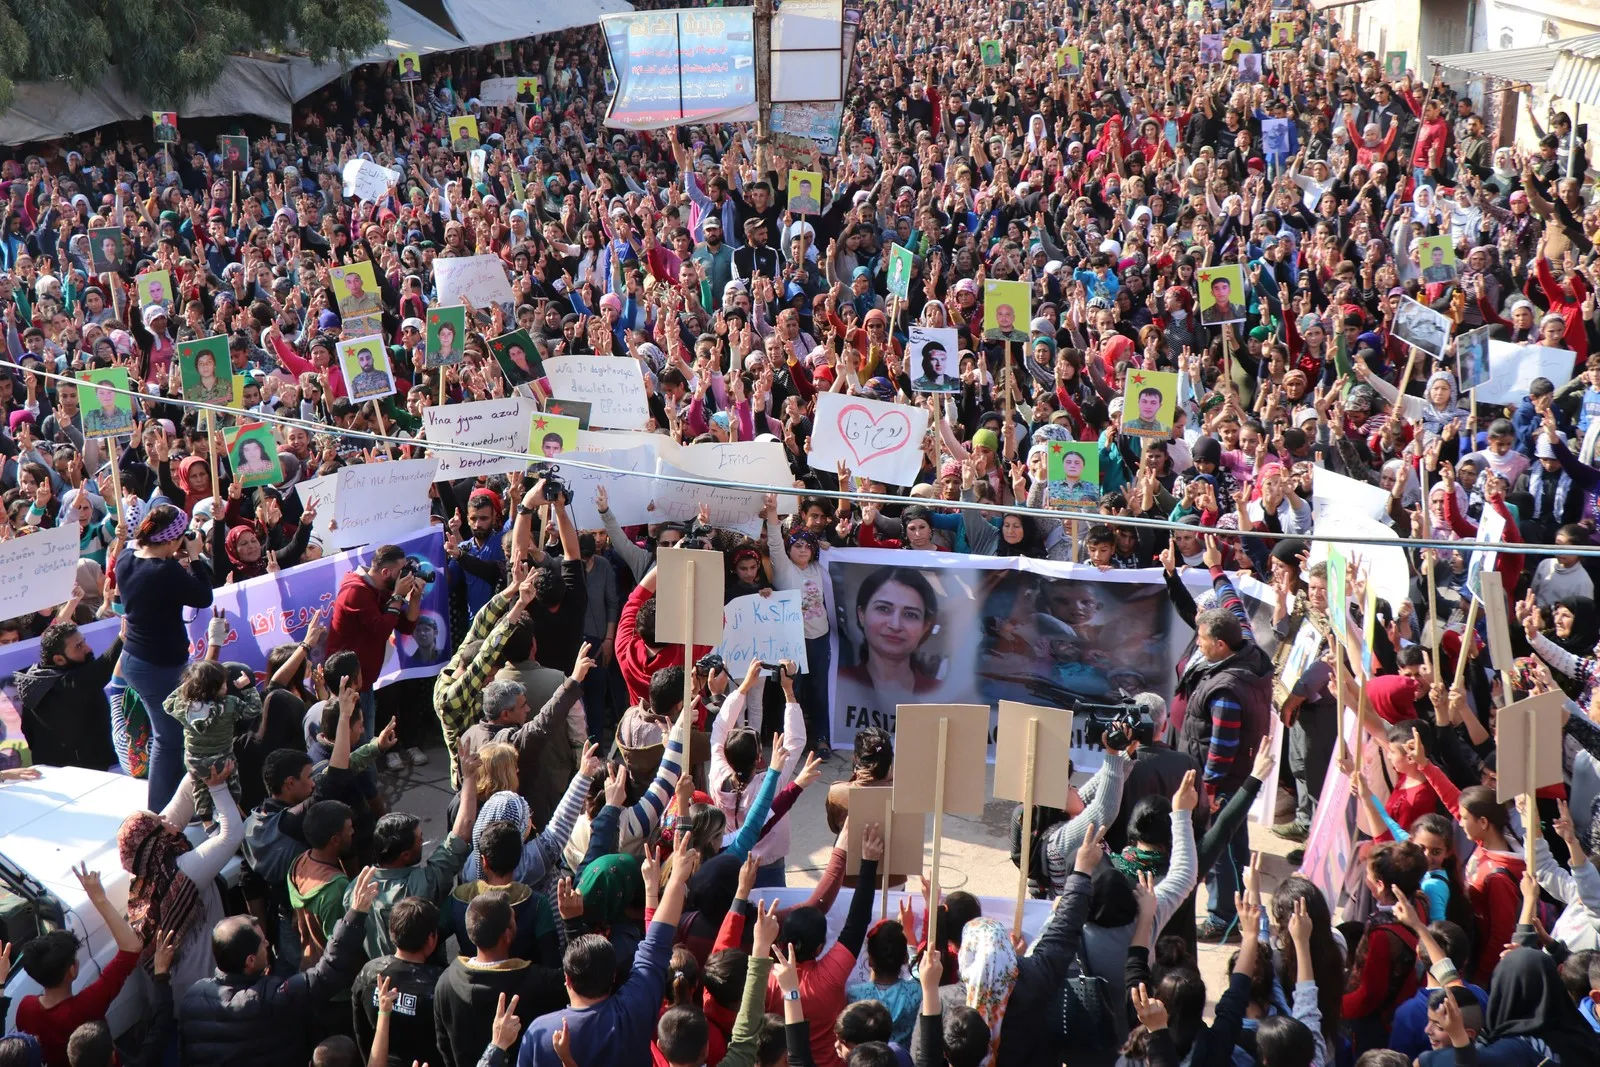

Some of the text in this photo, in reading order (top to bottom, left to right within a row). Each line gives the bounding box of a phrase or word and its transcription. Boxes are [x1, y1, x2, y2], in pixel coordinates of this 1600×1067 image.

[491, 402, 520, 419] azad
[440, 459, 450, 471] de
[732, 608, 743, 630] ji
